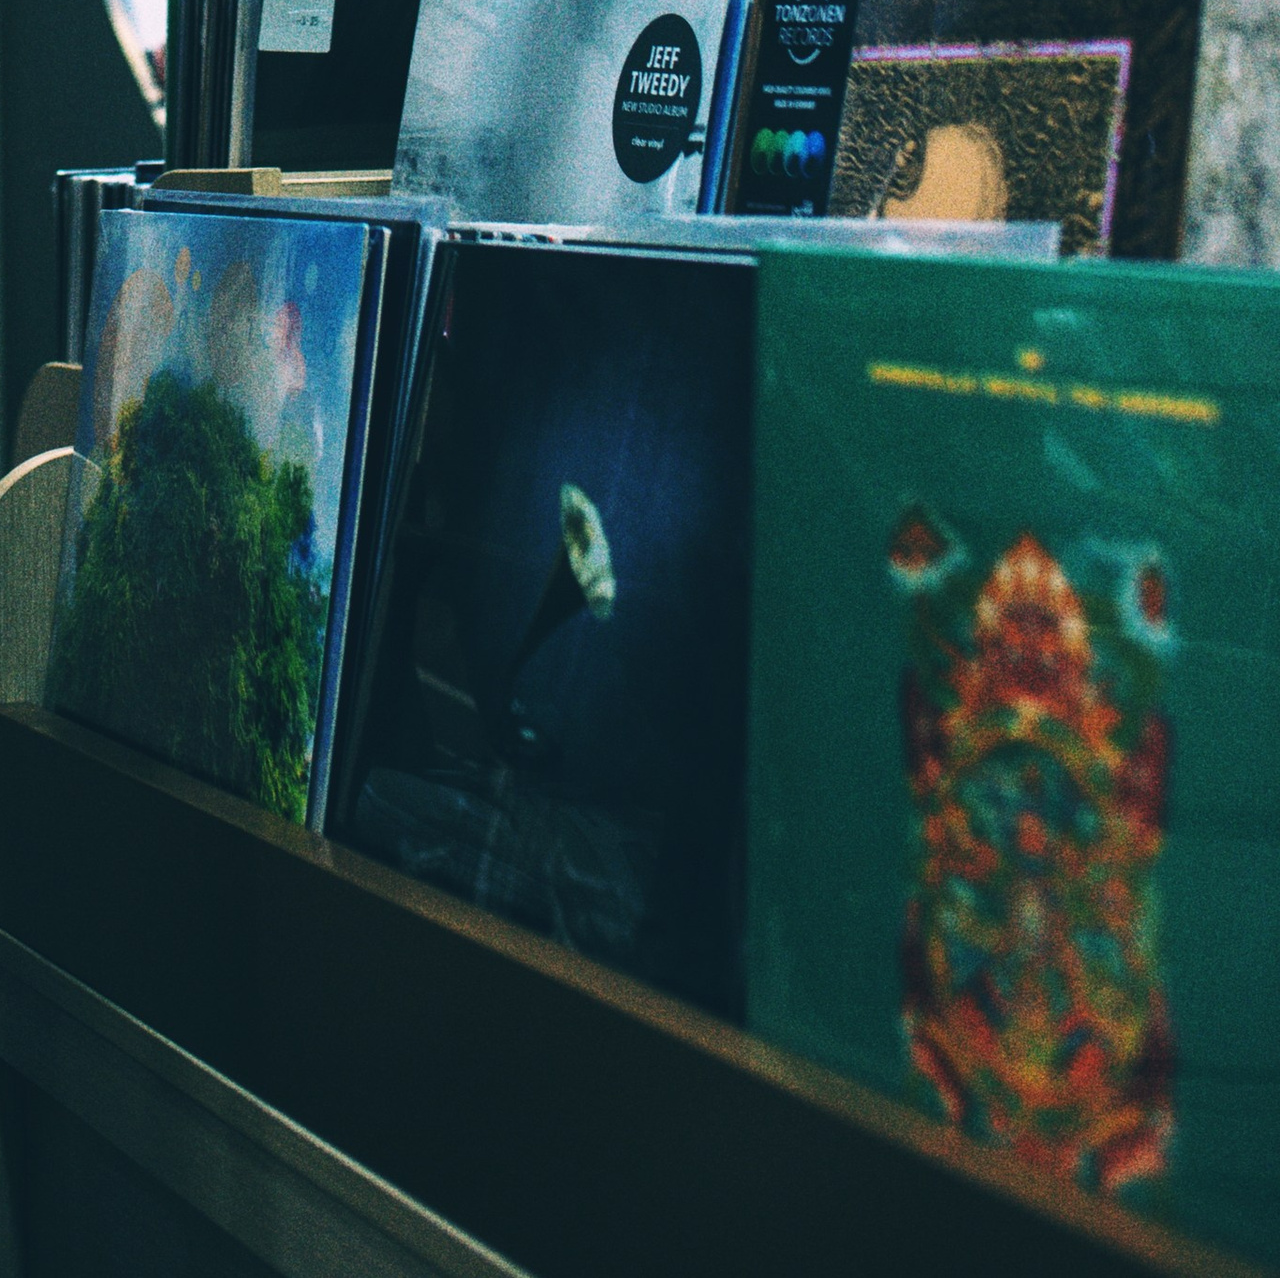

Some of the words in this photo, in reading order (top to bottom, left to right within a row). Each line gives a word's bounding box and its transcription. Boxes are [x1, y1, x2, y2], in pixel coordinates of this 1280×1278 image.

[775, 4, 847, 23] TONZONEN
[778, 26, 835, 46] RECORDS
[646, 45, 681, 69] JEFF
[630, 71, 691, 98] TWEEDY
[622, 100, 638, 112] NEW
[638, 101, 663, 114] STUDIO
[663, 104, 689, 118] ALBUM
[631, 136, 647, 147] clear
[647, 138, 665, 151] vinyl
